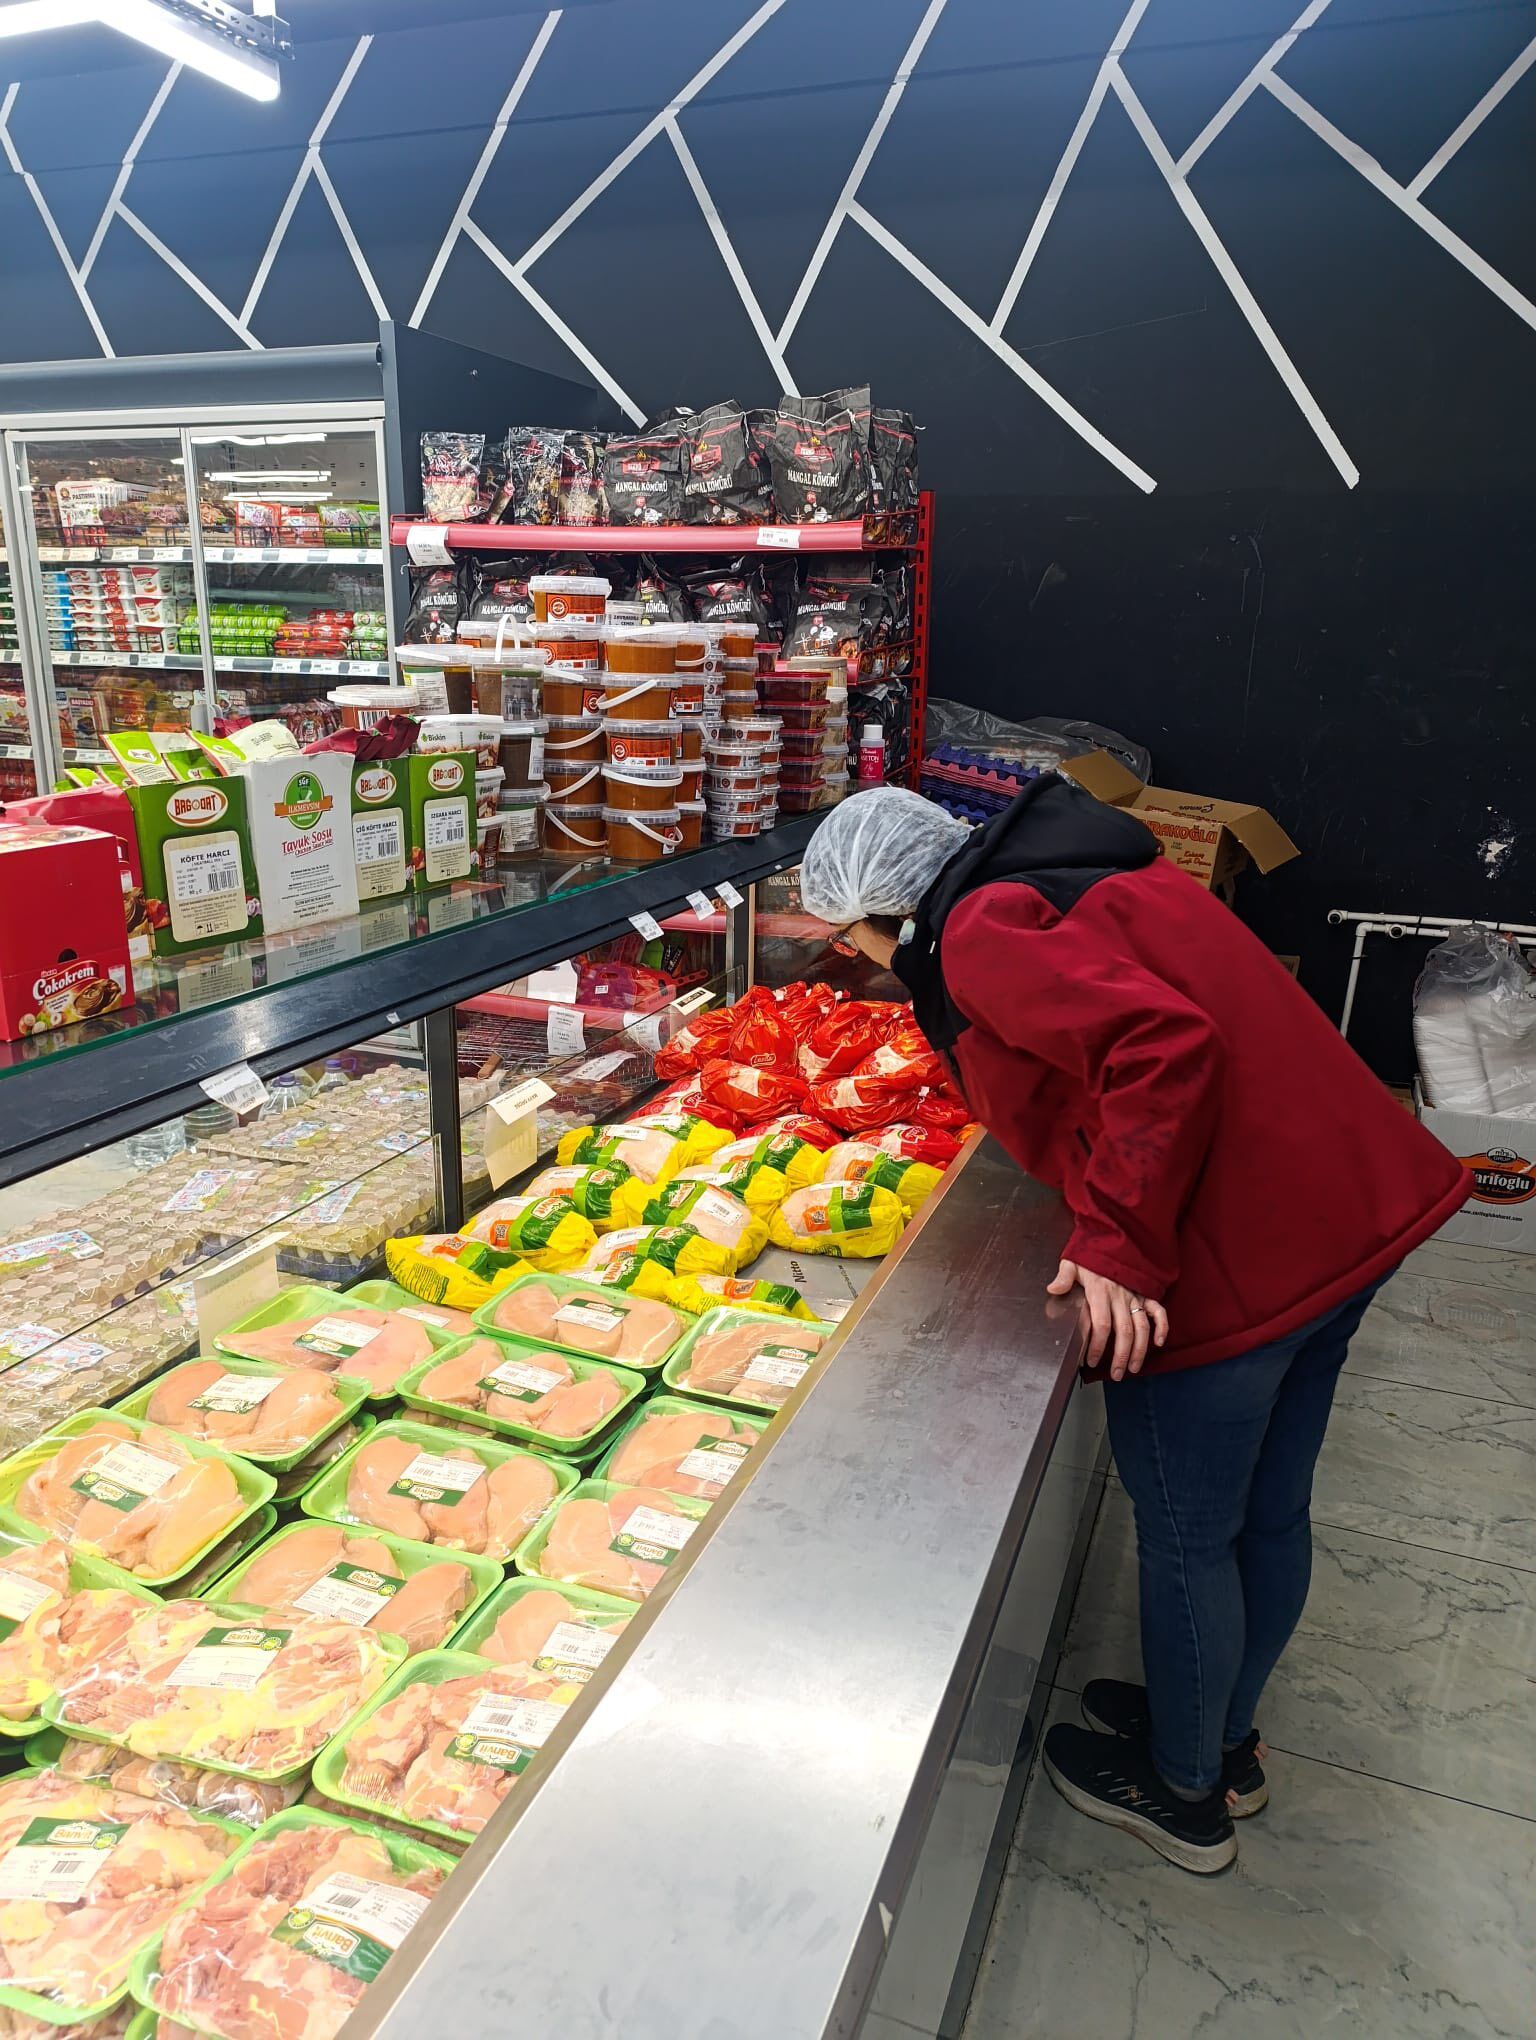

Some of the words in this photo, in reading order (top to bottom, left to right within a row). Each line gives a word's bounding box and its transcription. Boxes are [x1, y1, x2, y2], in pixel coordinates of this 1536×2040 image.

[705, 473, 733, 494] KÖMÜRÜ
[788, 469, 811, 486] MANGAL
[615, 480, 640, 493] MANGAL
[641, 480, 668, 492] KÖMÜRÜ
[433, 592, 458, 606] KÖMÜRÜ
[428, 734, 446, 742] Biskin
[366, 822, 382, 832] KÖFTE
[382, 820, 398, 830] HARCI
[281, 834, 310, 855] Tavuk
[312, 828, 332, 845] Sosu
[180, 854, 206, 864] KÖFTE
[206, 849, 230, 862] HARCI
[32, 966, 94, 1006] Çokokrem
[790, 1260, 807, 1284] Nitto
[352, 1572, 380, 1586] Banvit
[227, 1632, 260, 1641] Banvit
[560, 1666, 590, 1680] Banvit
[480, 1744, 517, 1760] Banvit
[54, 1829, 94, 1840] Banvit
[311, 1925, 354, 1952] Banvit
